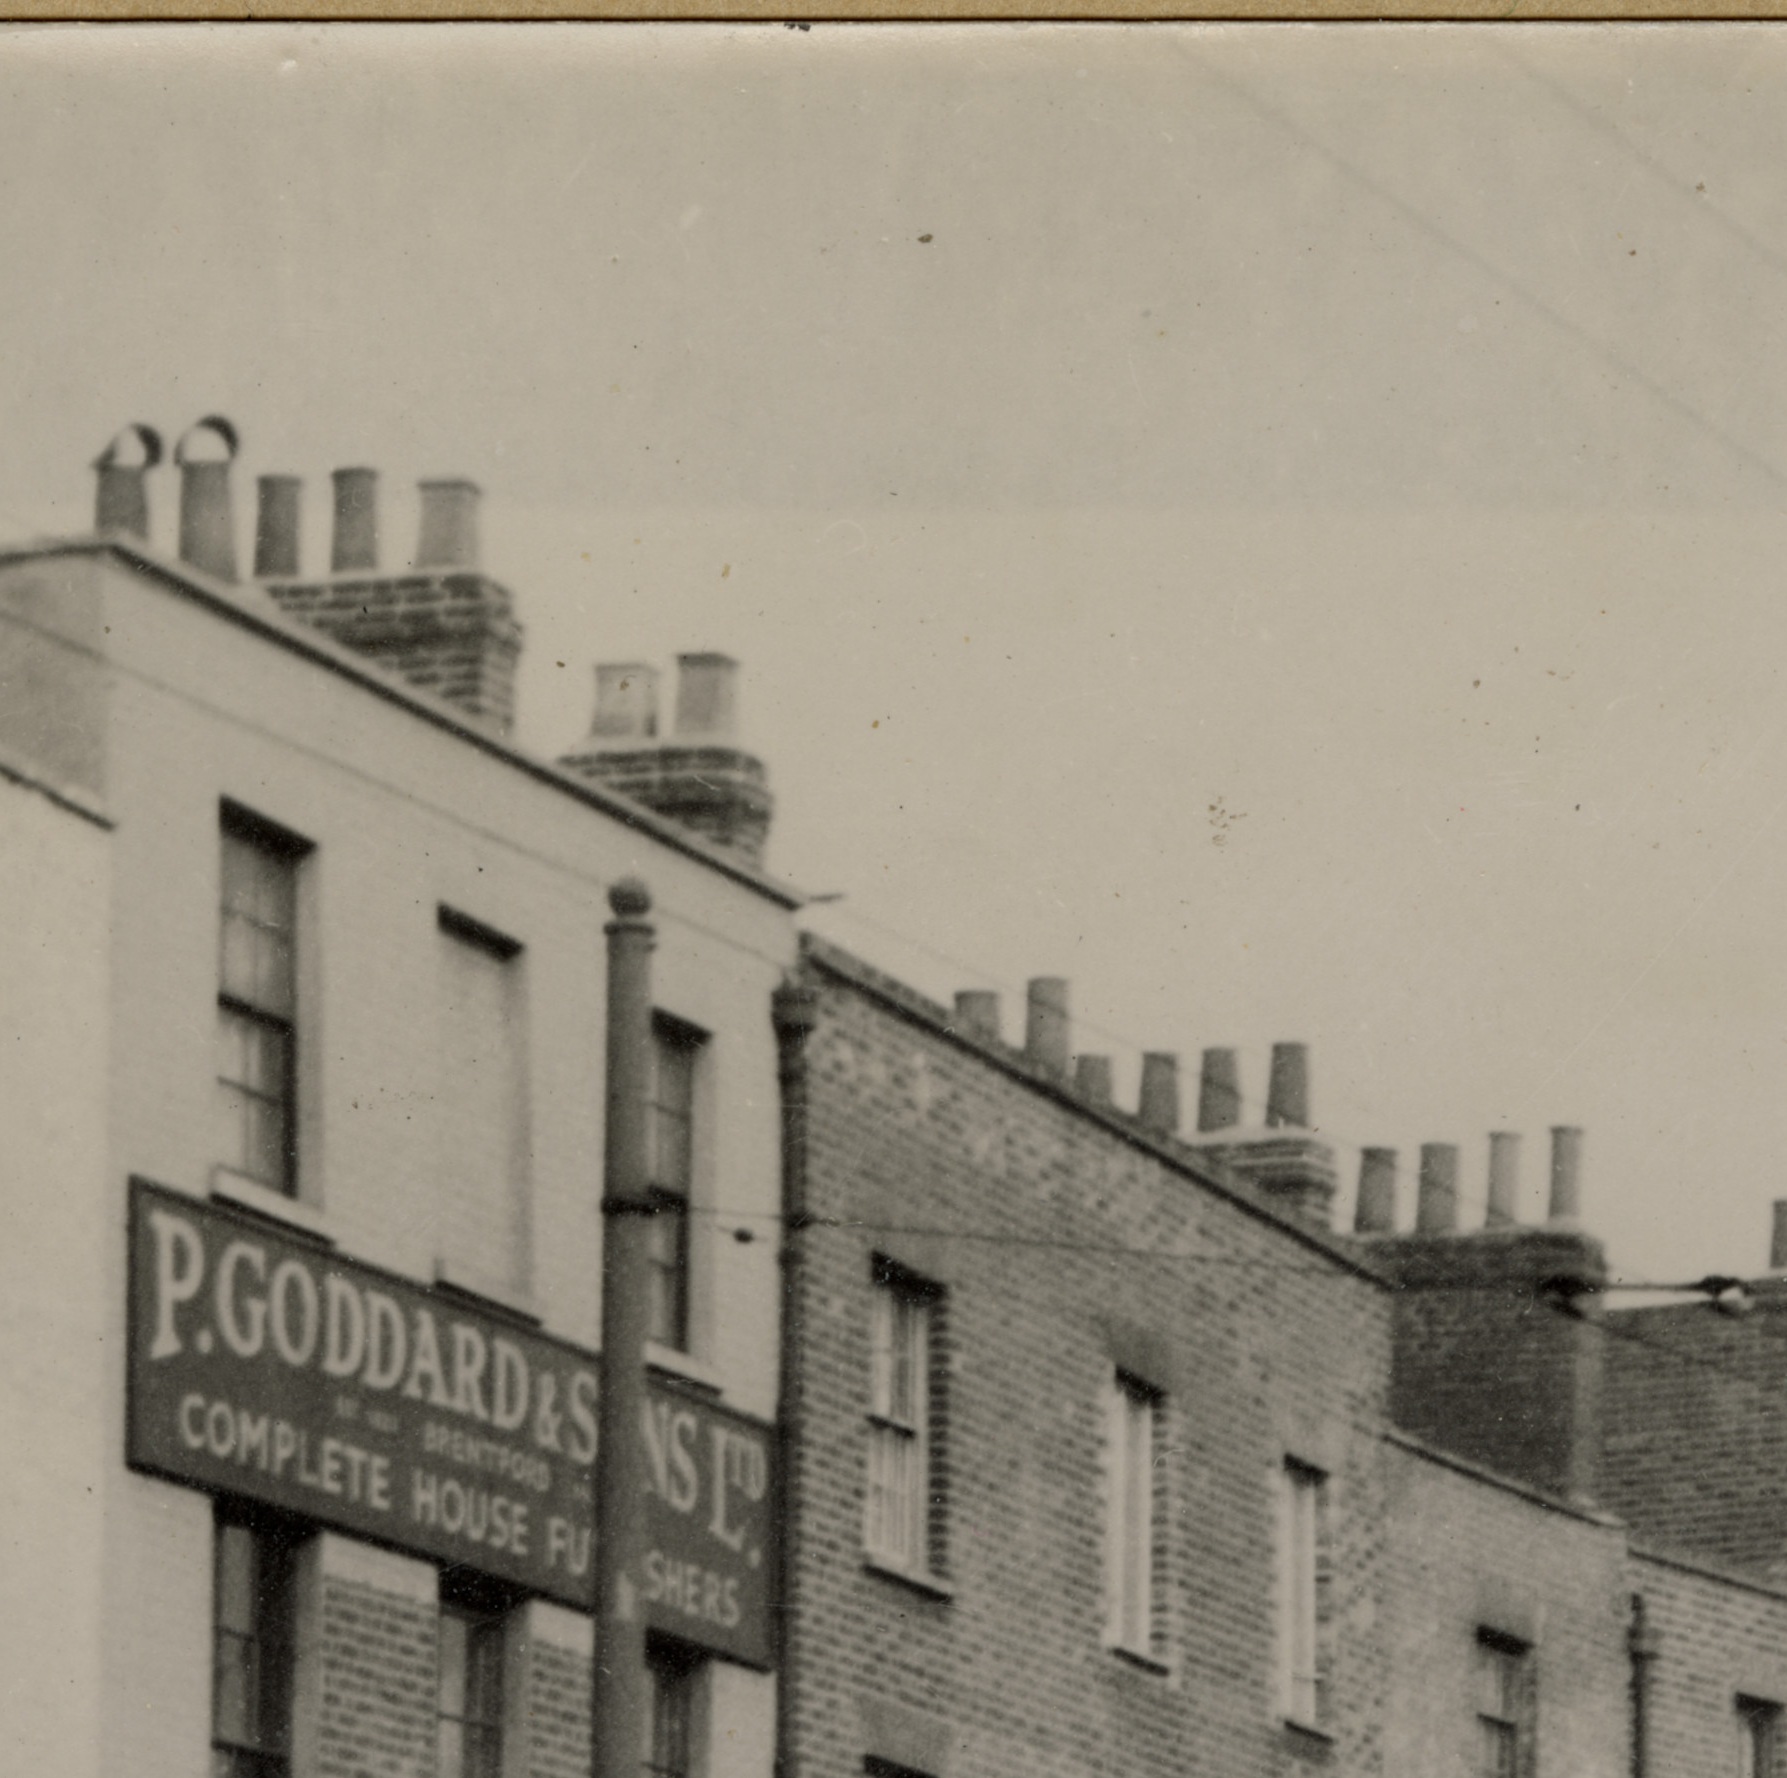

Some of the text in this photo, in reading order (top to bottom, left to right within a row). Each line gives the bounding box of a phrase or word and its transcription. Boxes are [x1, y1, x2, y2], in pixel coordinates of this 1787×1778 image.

[179, 1394, 741, 1628] COMPLETE HOUSE FUSHERS
